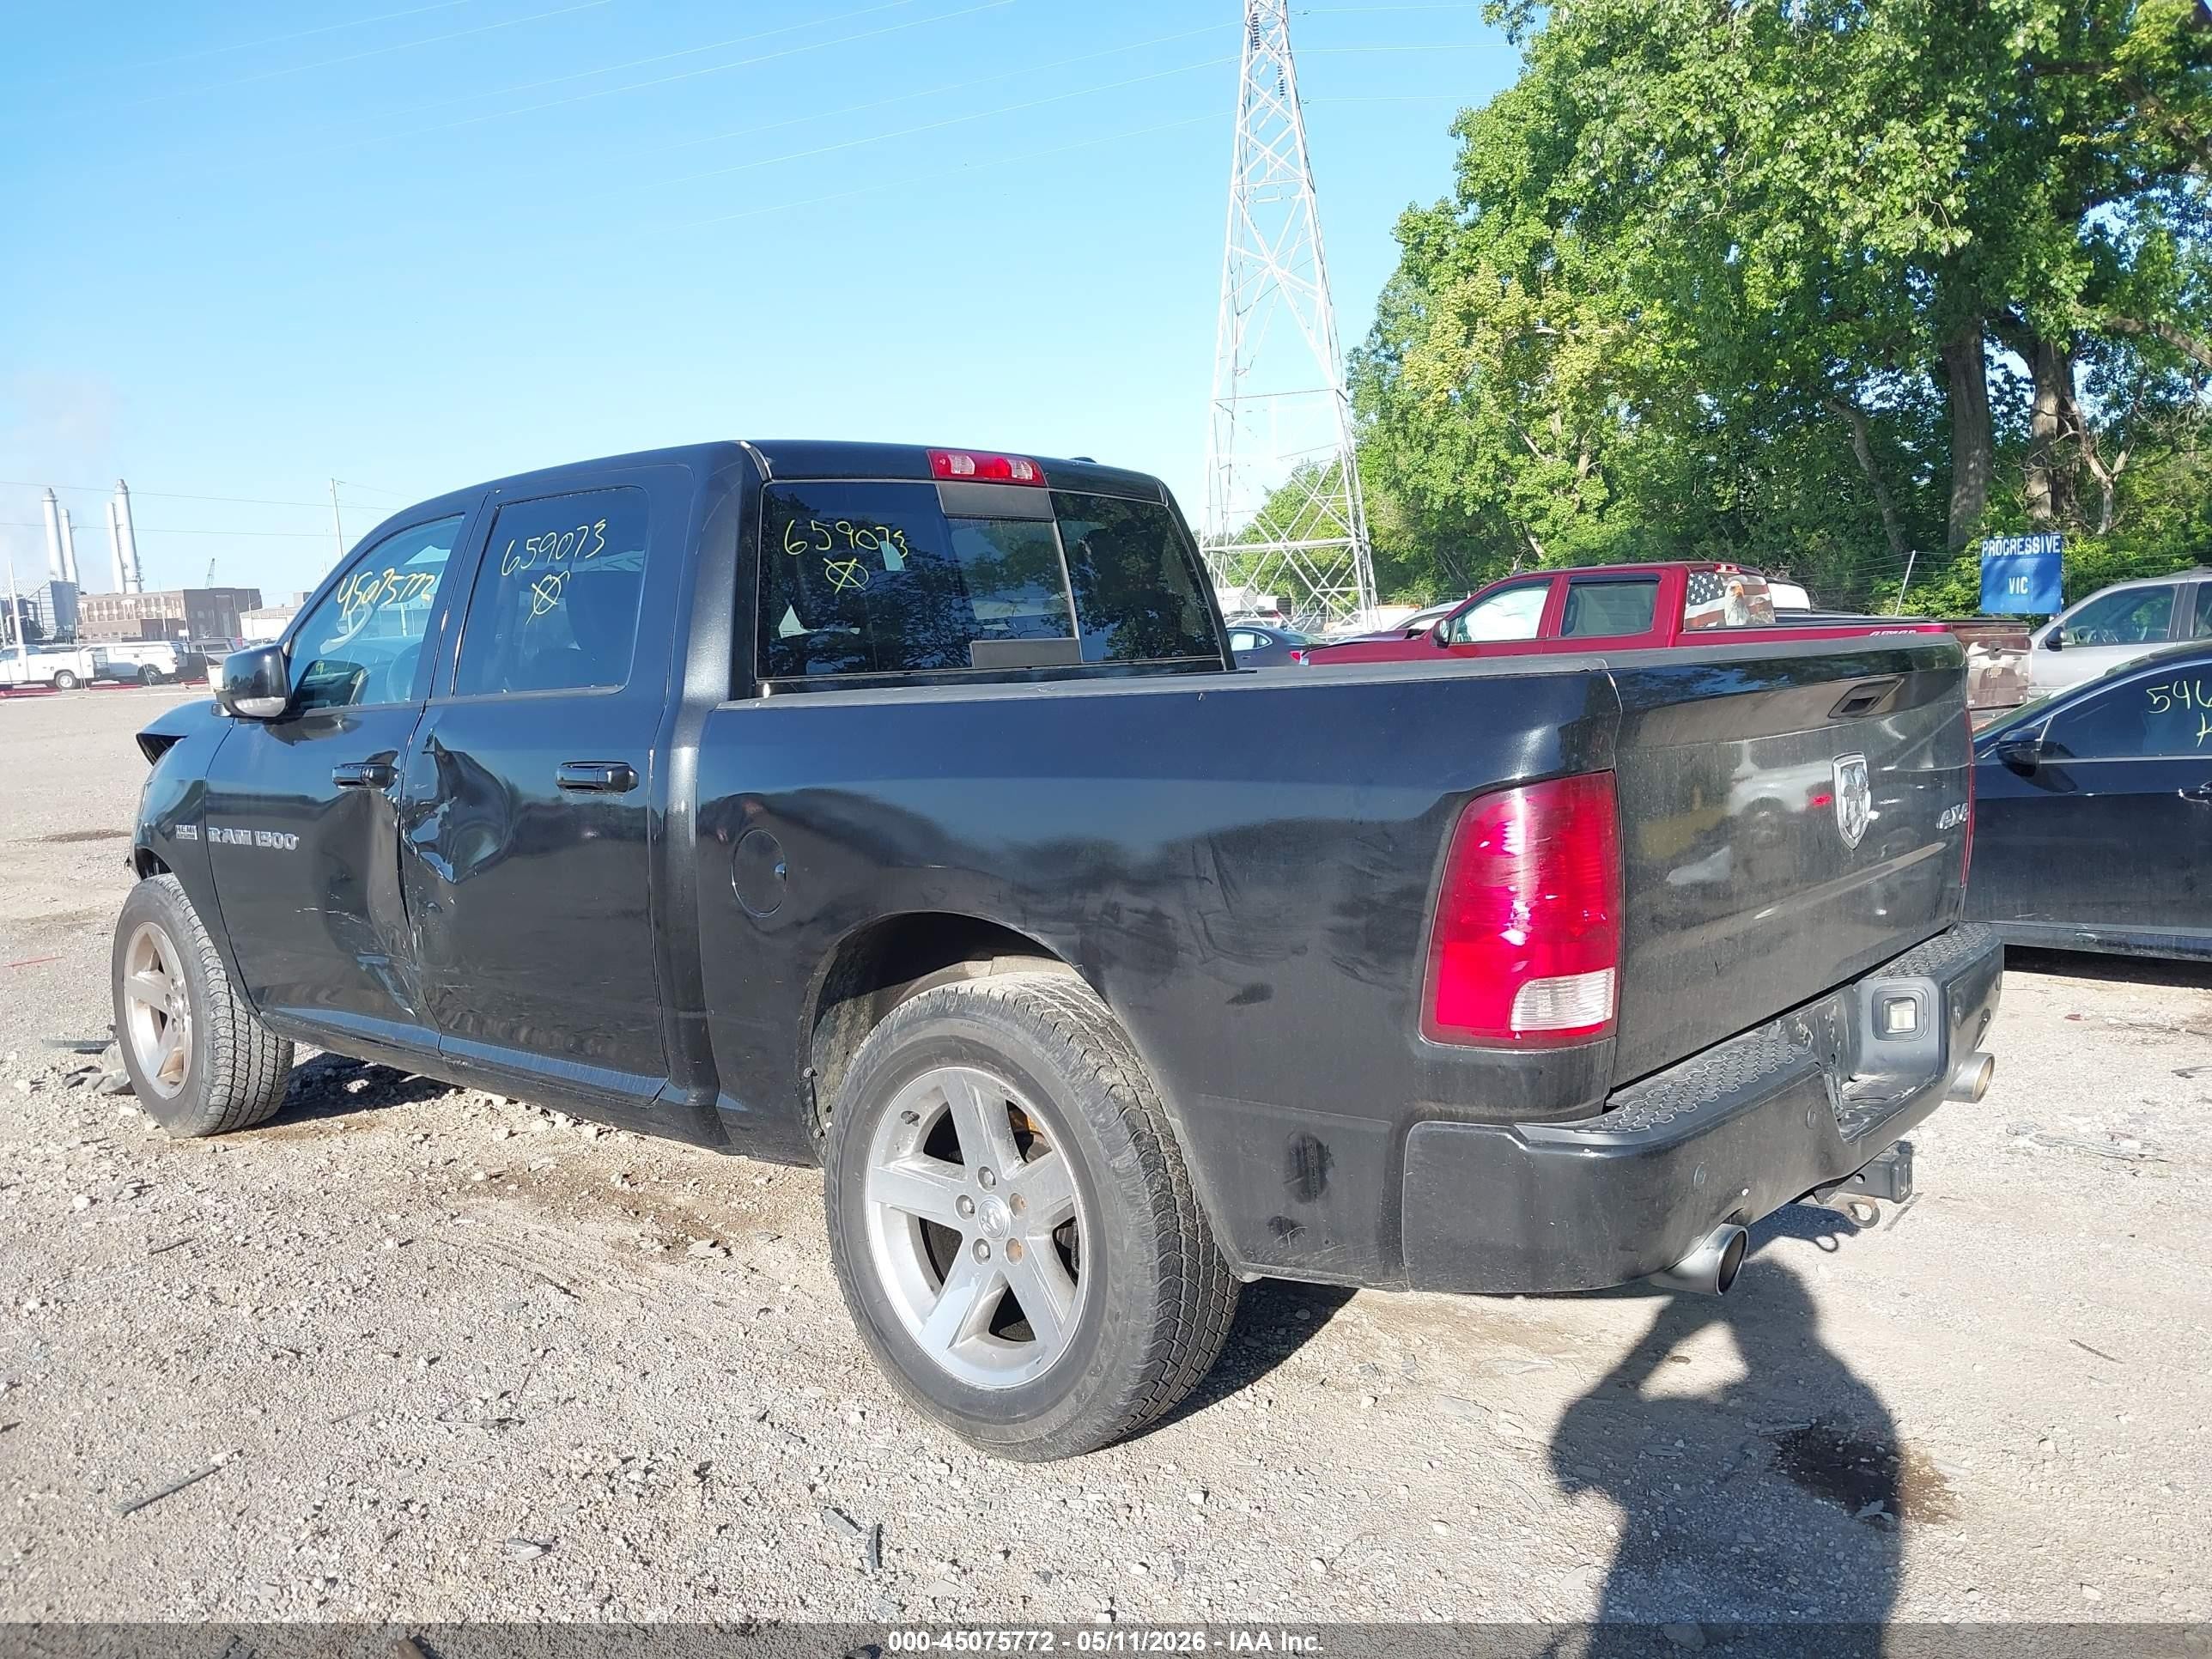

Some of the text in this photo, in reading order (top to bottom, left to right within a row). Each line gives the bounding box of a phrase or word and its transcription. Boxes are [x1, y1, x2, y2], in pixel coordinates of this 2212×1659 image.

[501, 519, 606, 576] 659073
[784, 519, 908, 558] 659073
[1982, 535, 2061, 556] PROGRESSIVE
[2008, 576, 2028, 594] VIC
[209, 827, 298, 851] RAM 1500
